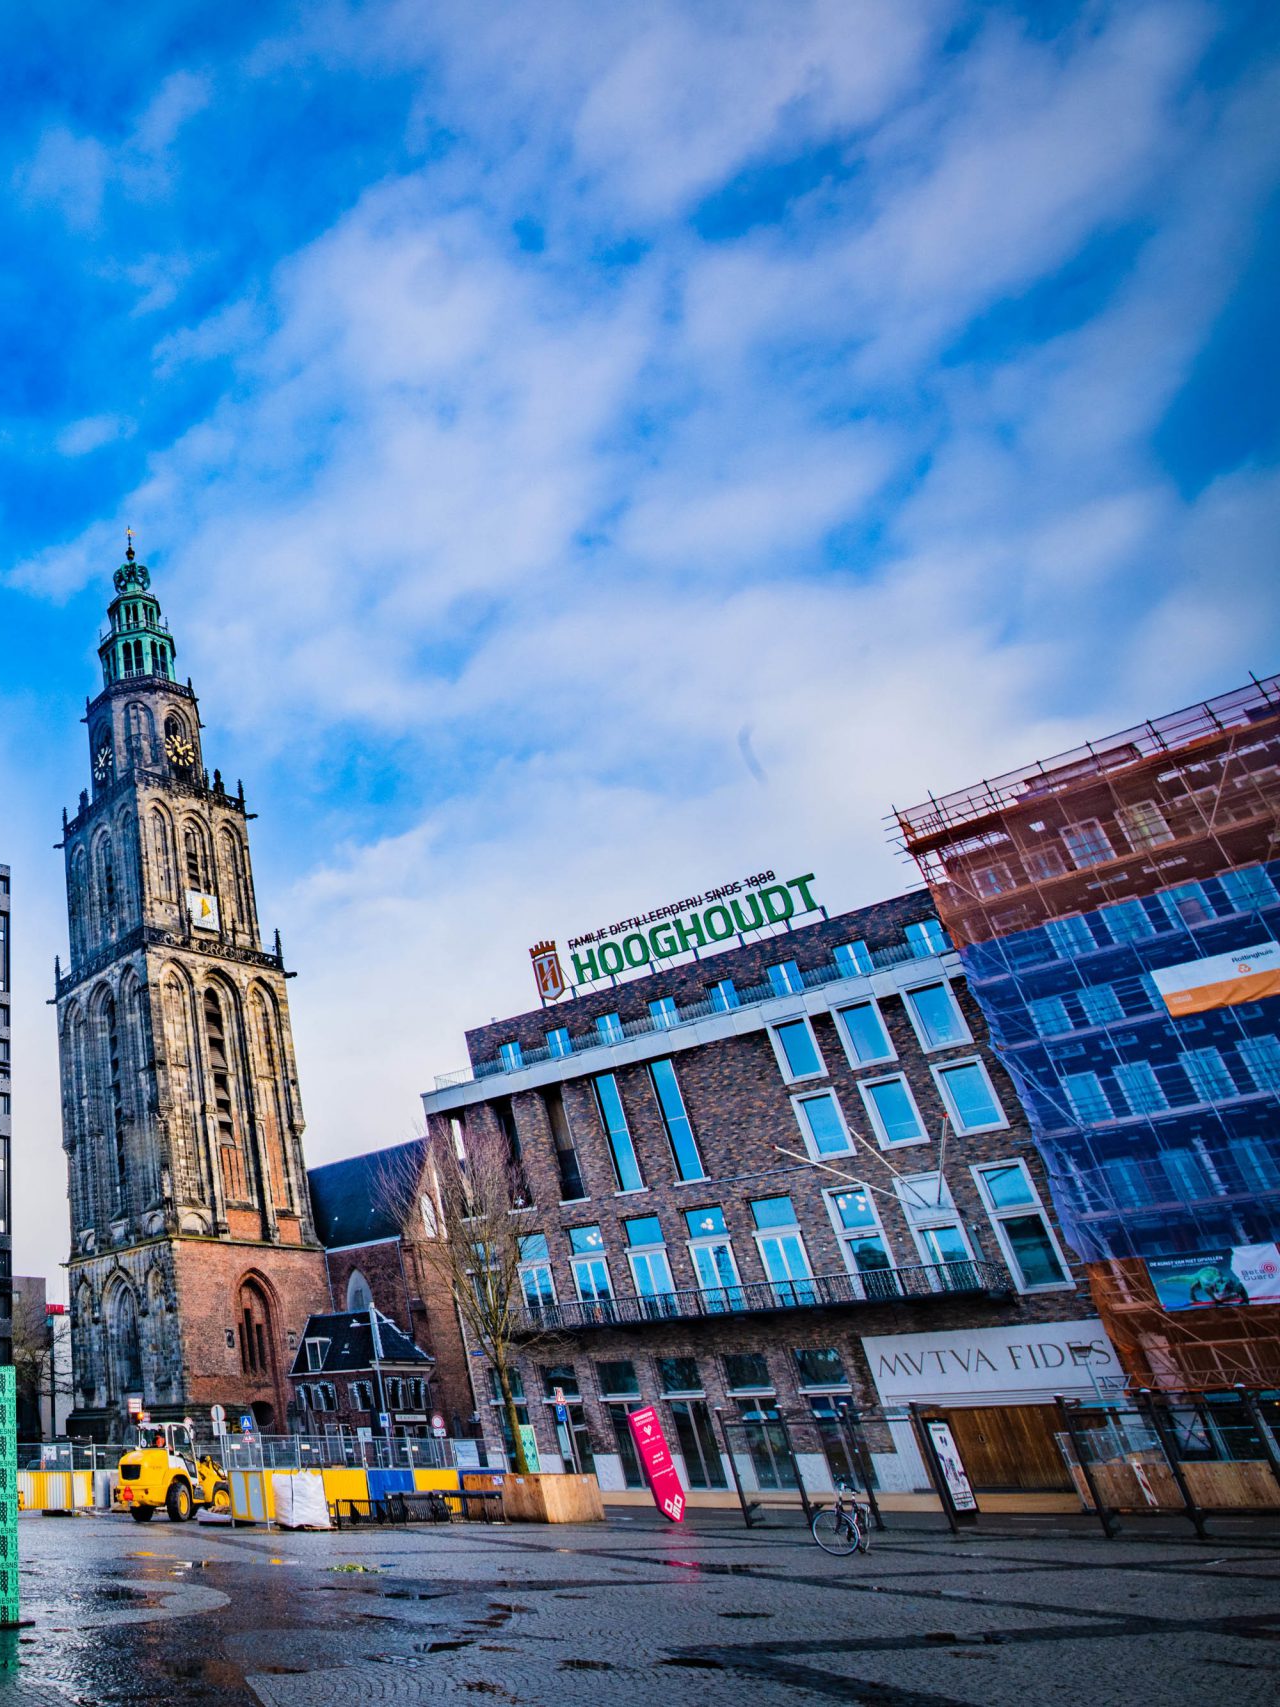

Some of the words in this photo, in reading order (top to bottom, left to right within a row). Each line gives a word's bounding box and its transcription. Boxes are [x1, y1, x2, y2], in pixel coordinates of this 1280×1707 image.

[567, 927, 609, 950] FAMILIE
[609, 896, 703, 935] DISTILLEERDERIJ
[704, 881, 743, 903] SINDS
[744, 869, 776, 889] 1888
[570, 872, 817, 985] HOOGHOUDT
[878, 1347, 997, 1378] MVTVA
[1006, 1339, 1112, 1371] FIDES
